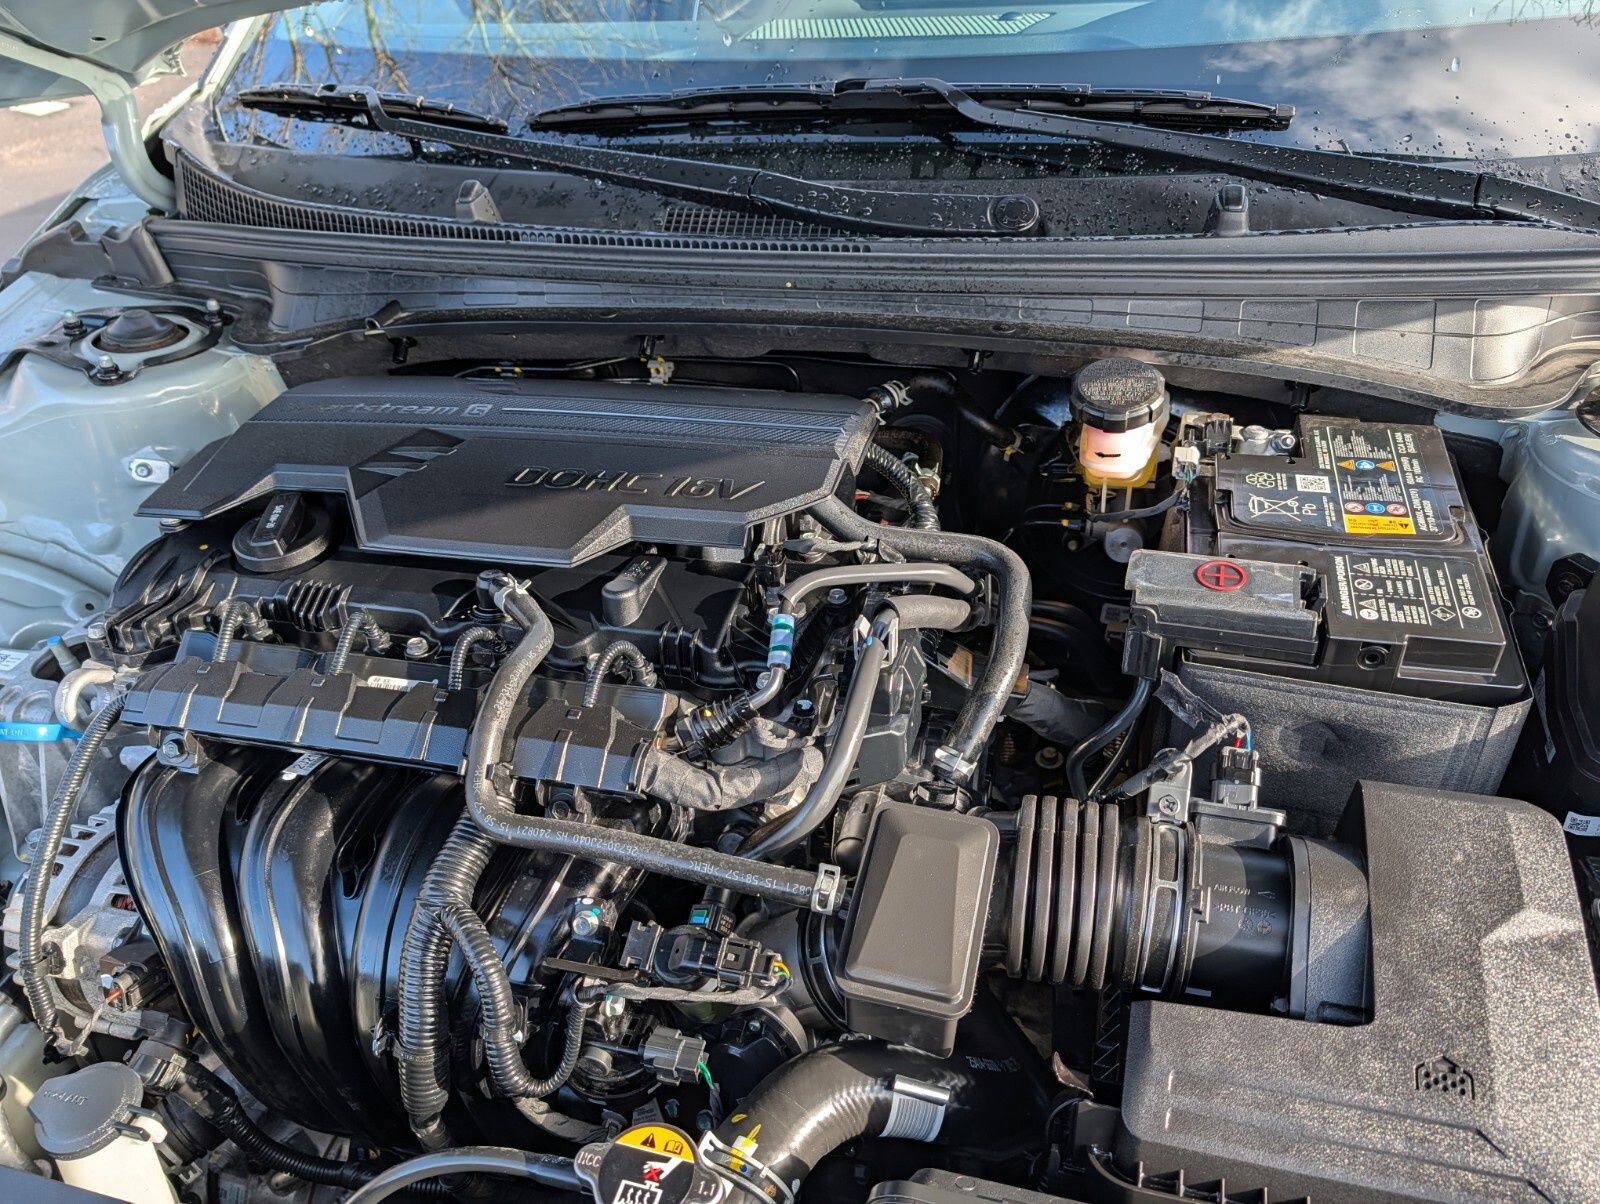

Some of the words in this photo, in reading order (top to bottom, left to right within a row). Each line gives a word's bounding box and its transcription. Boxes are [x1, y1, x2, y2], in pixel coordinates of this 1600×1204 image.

[504, 464, 664, 495] DOHC
[664, 474, 766, 501] 16V
[1303, 503, 1318, 516] Pb
[1334, 556, 1350, 609] DANGER/POISON
[516, 824, 552, 841] 240821
[555, 831, 570, 843] HS
